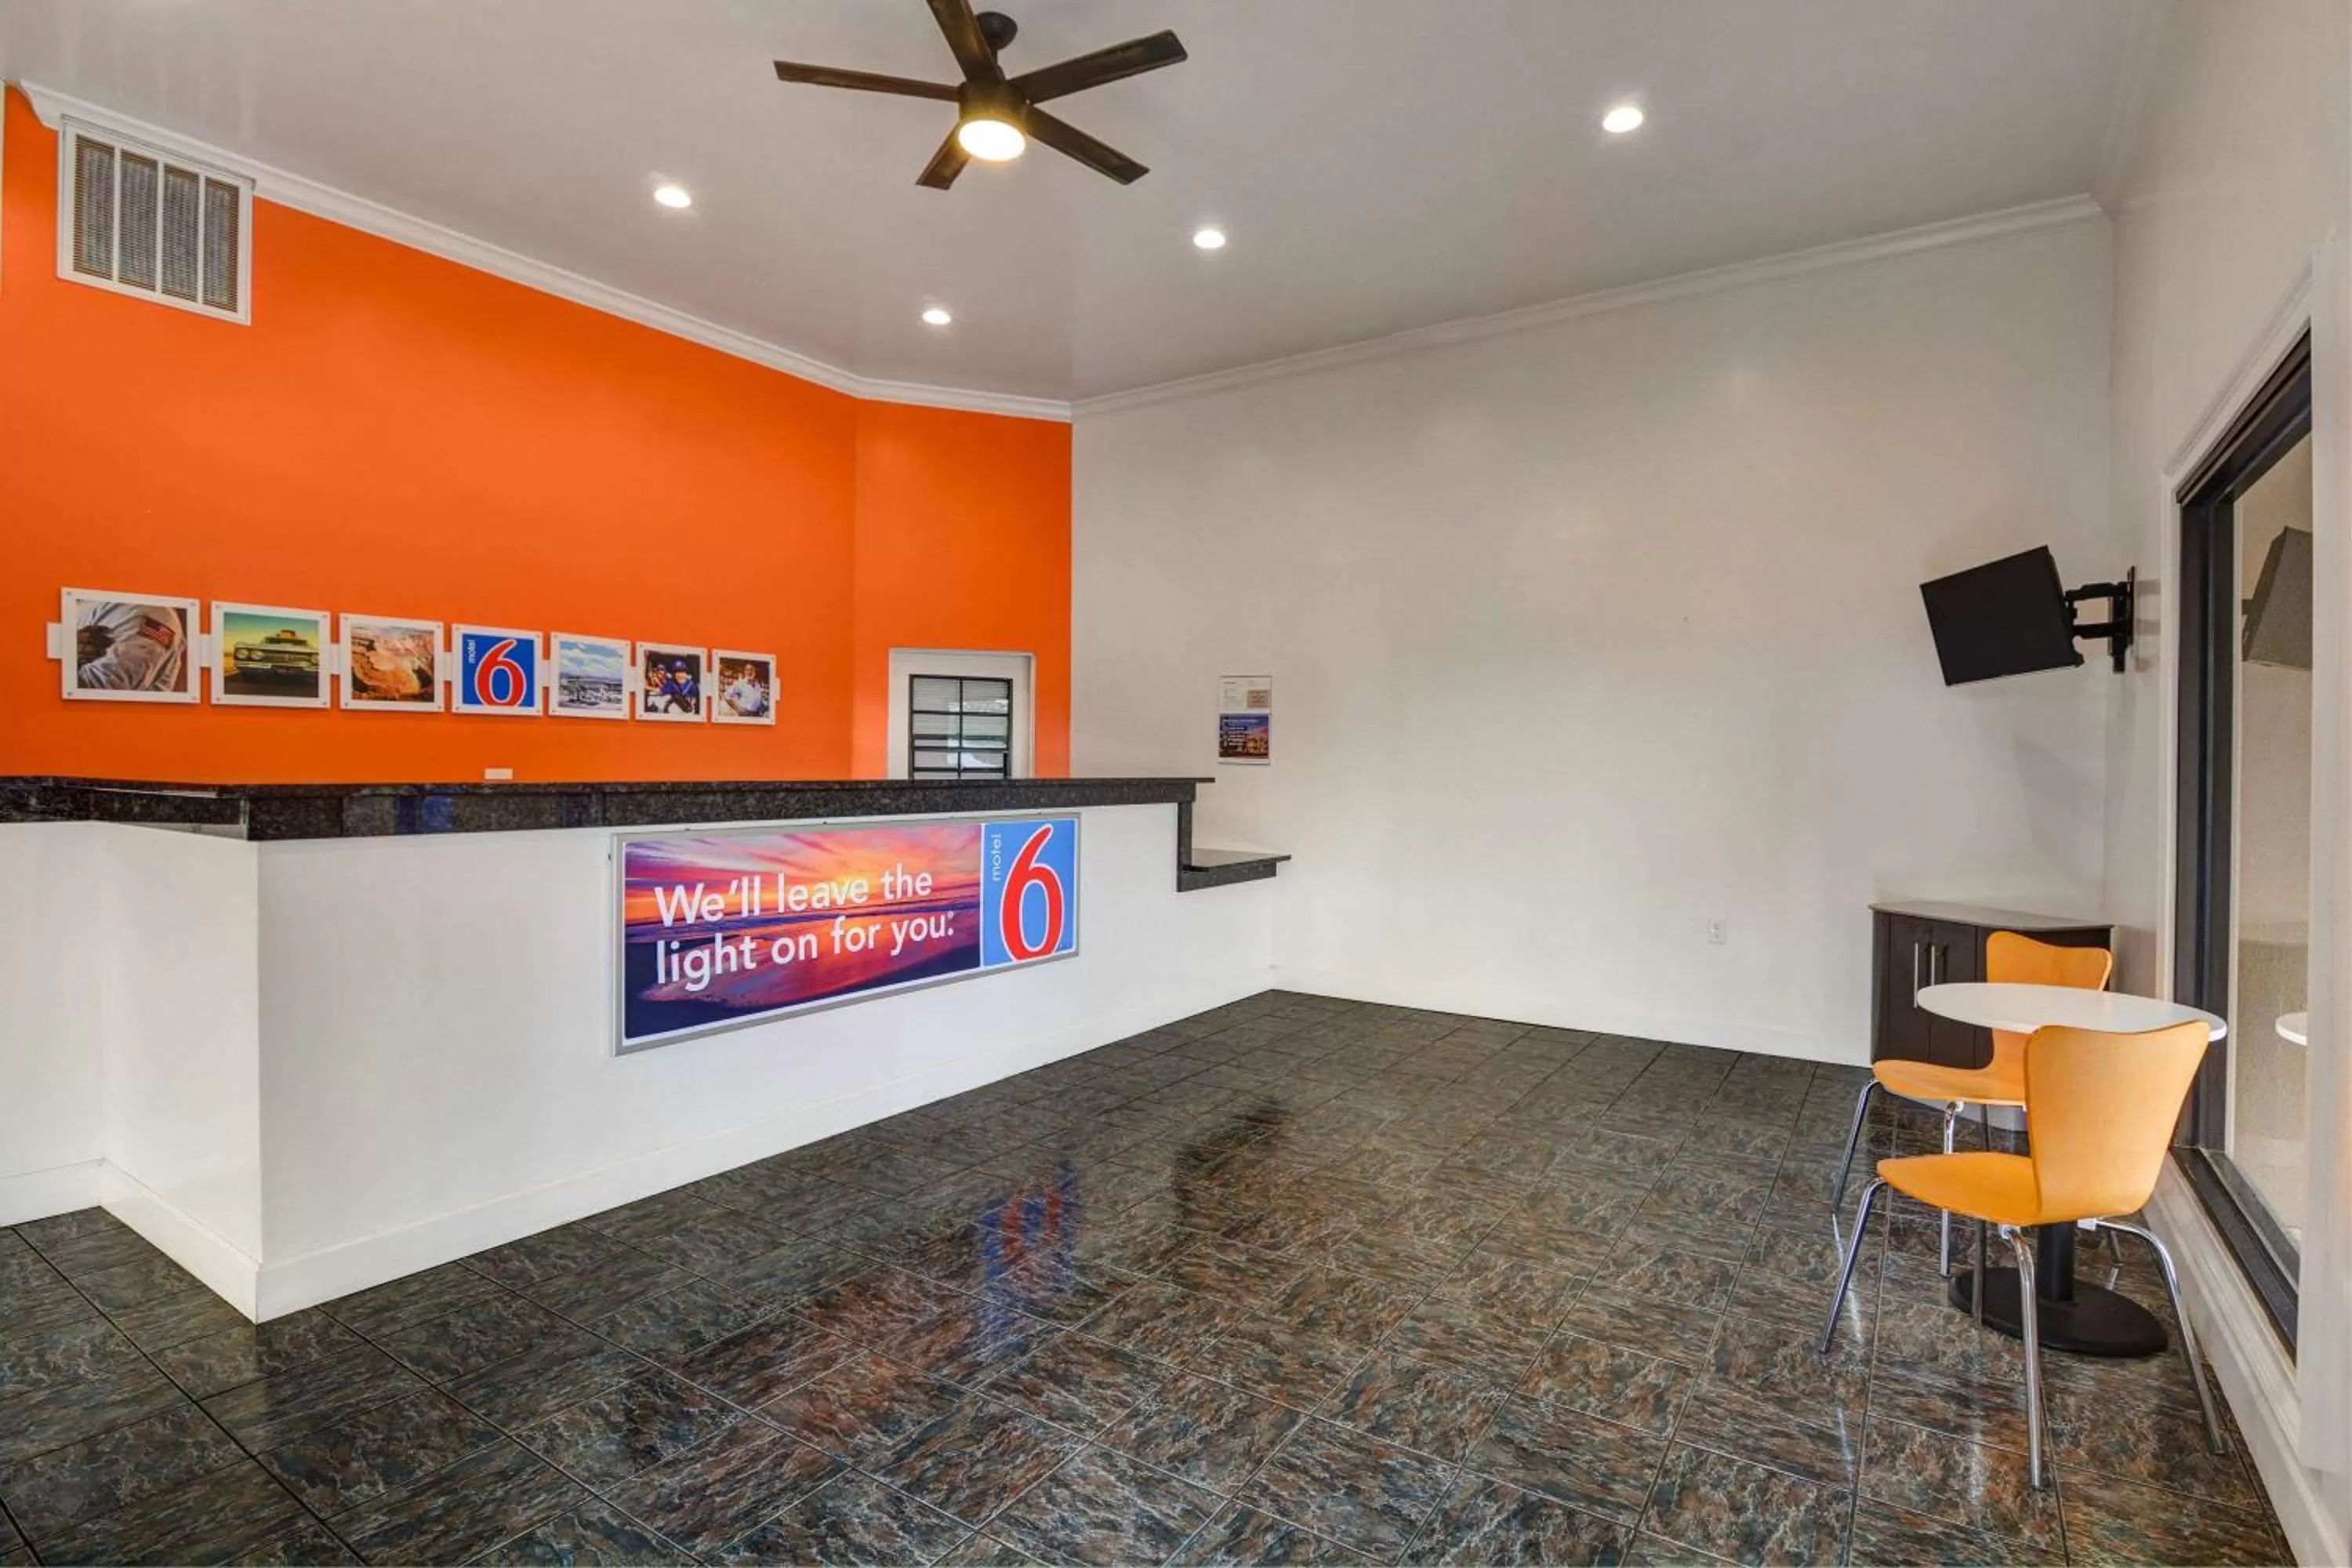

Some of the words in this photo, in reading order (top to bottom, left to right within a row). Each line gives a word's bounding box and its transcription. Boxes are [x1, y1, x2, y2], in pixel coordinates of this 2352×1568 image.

[474, 639, 527, 706] 6
[654, 875, 760, 927] We'll
[778, 871, 869, 913] leave
[880, 862, 933, 900] the
[991, 833, 1002, 881] motel
[1000, 823, 1065, 964] 6
[657, 932, 757, 992] light
[771, 932, 818, 965] on
[830, 915, 881, 954] for
